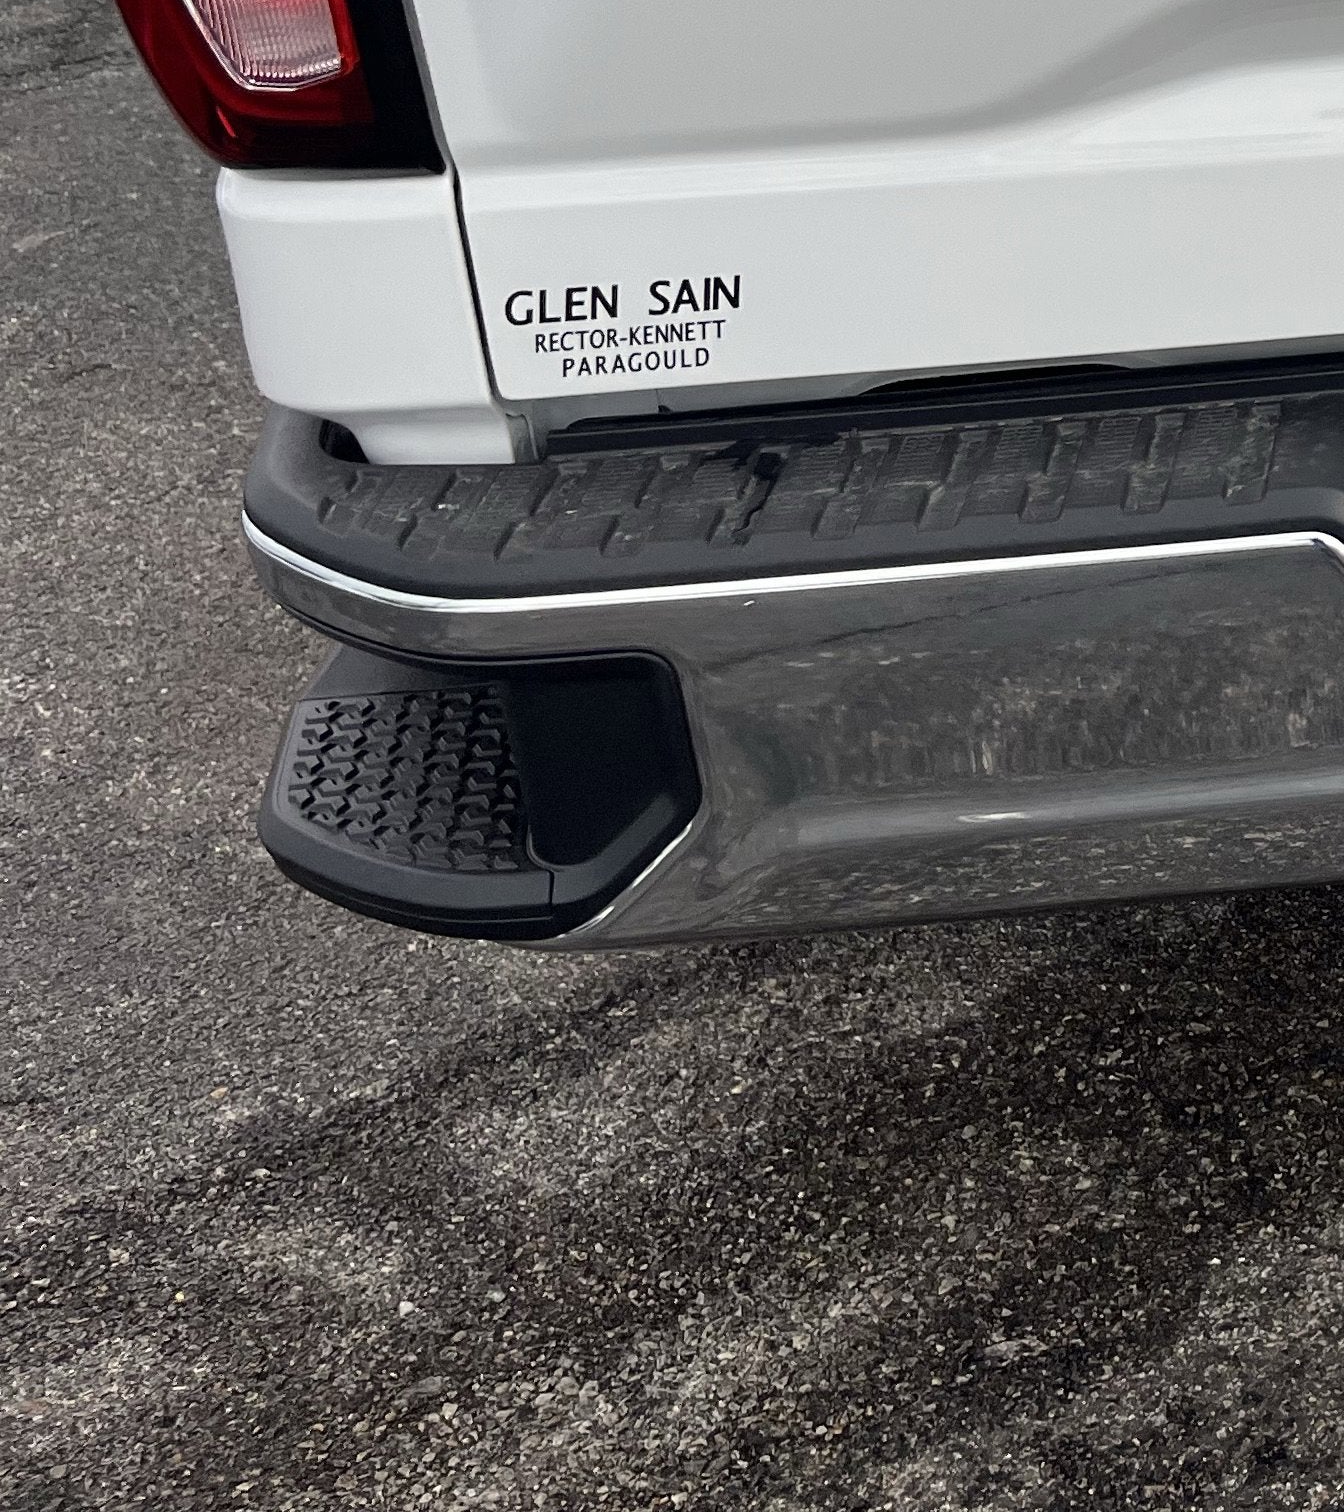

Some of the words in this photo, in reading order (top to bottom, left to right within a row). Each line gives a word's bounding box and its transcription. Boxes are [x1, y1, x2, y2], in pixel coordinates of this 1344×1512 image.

[504, 284, 619, 326] GLEN
[648, 275, 741, 316] SAIN
[535, 319, 726, 354] RECTOR-KENNETT
[562, 347, 710, 378] PARAGOULD
